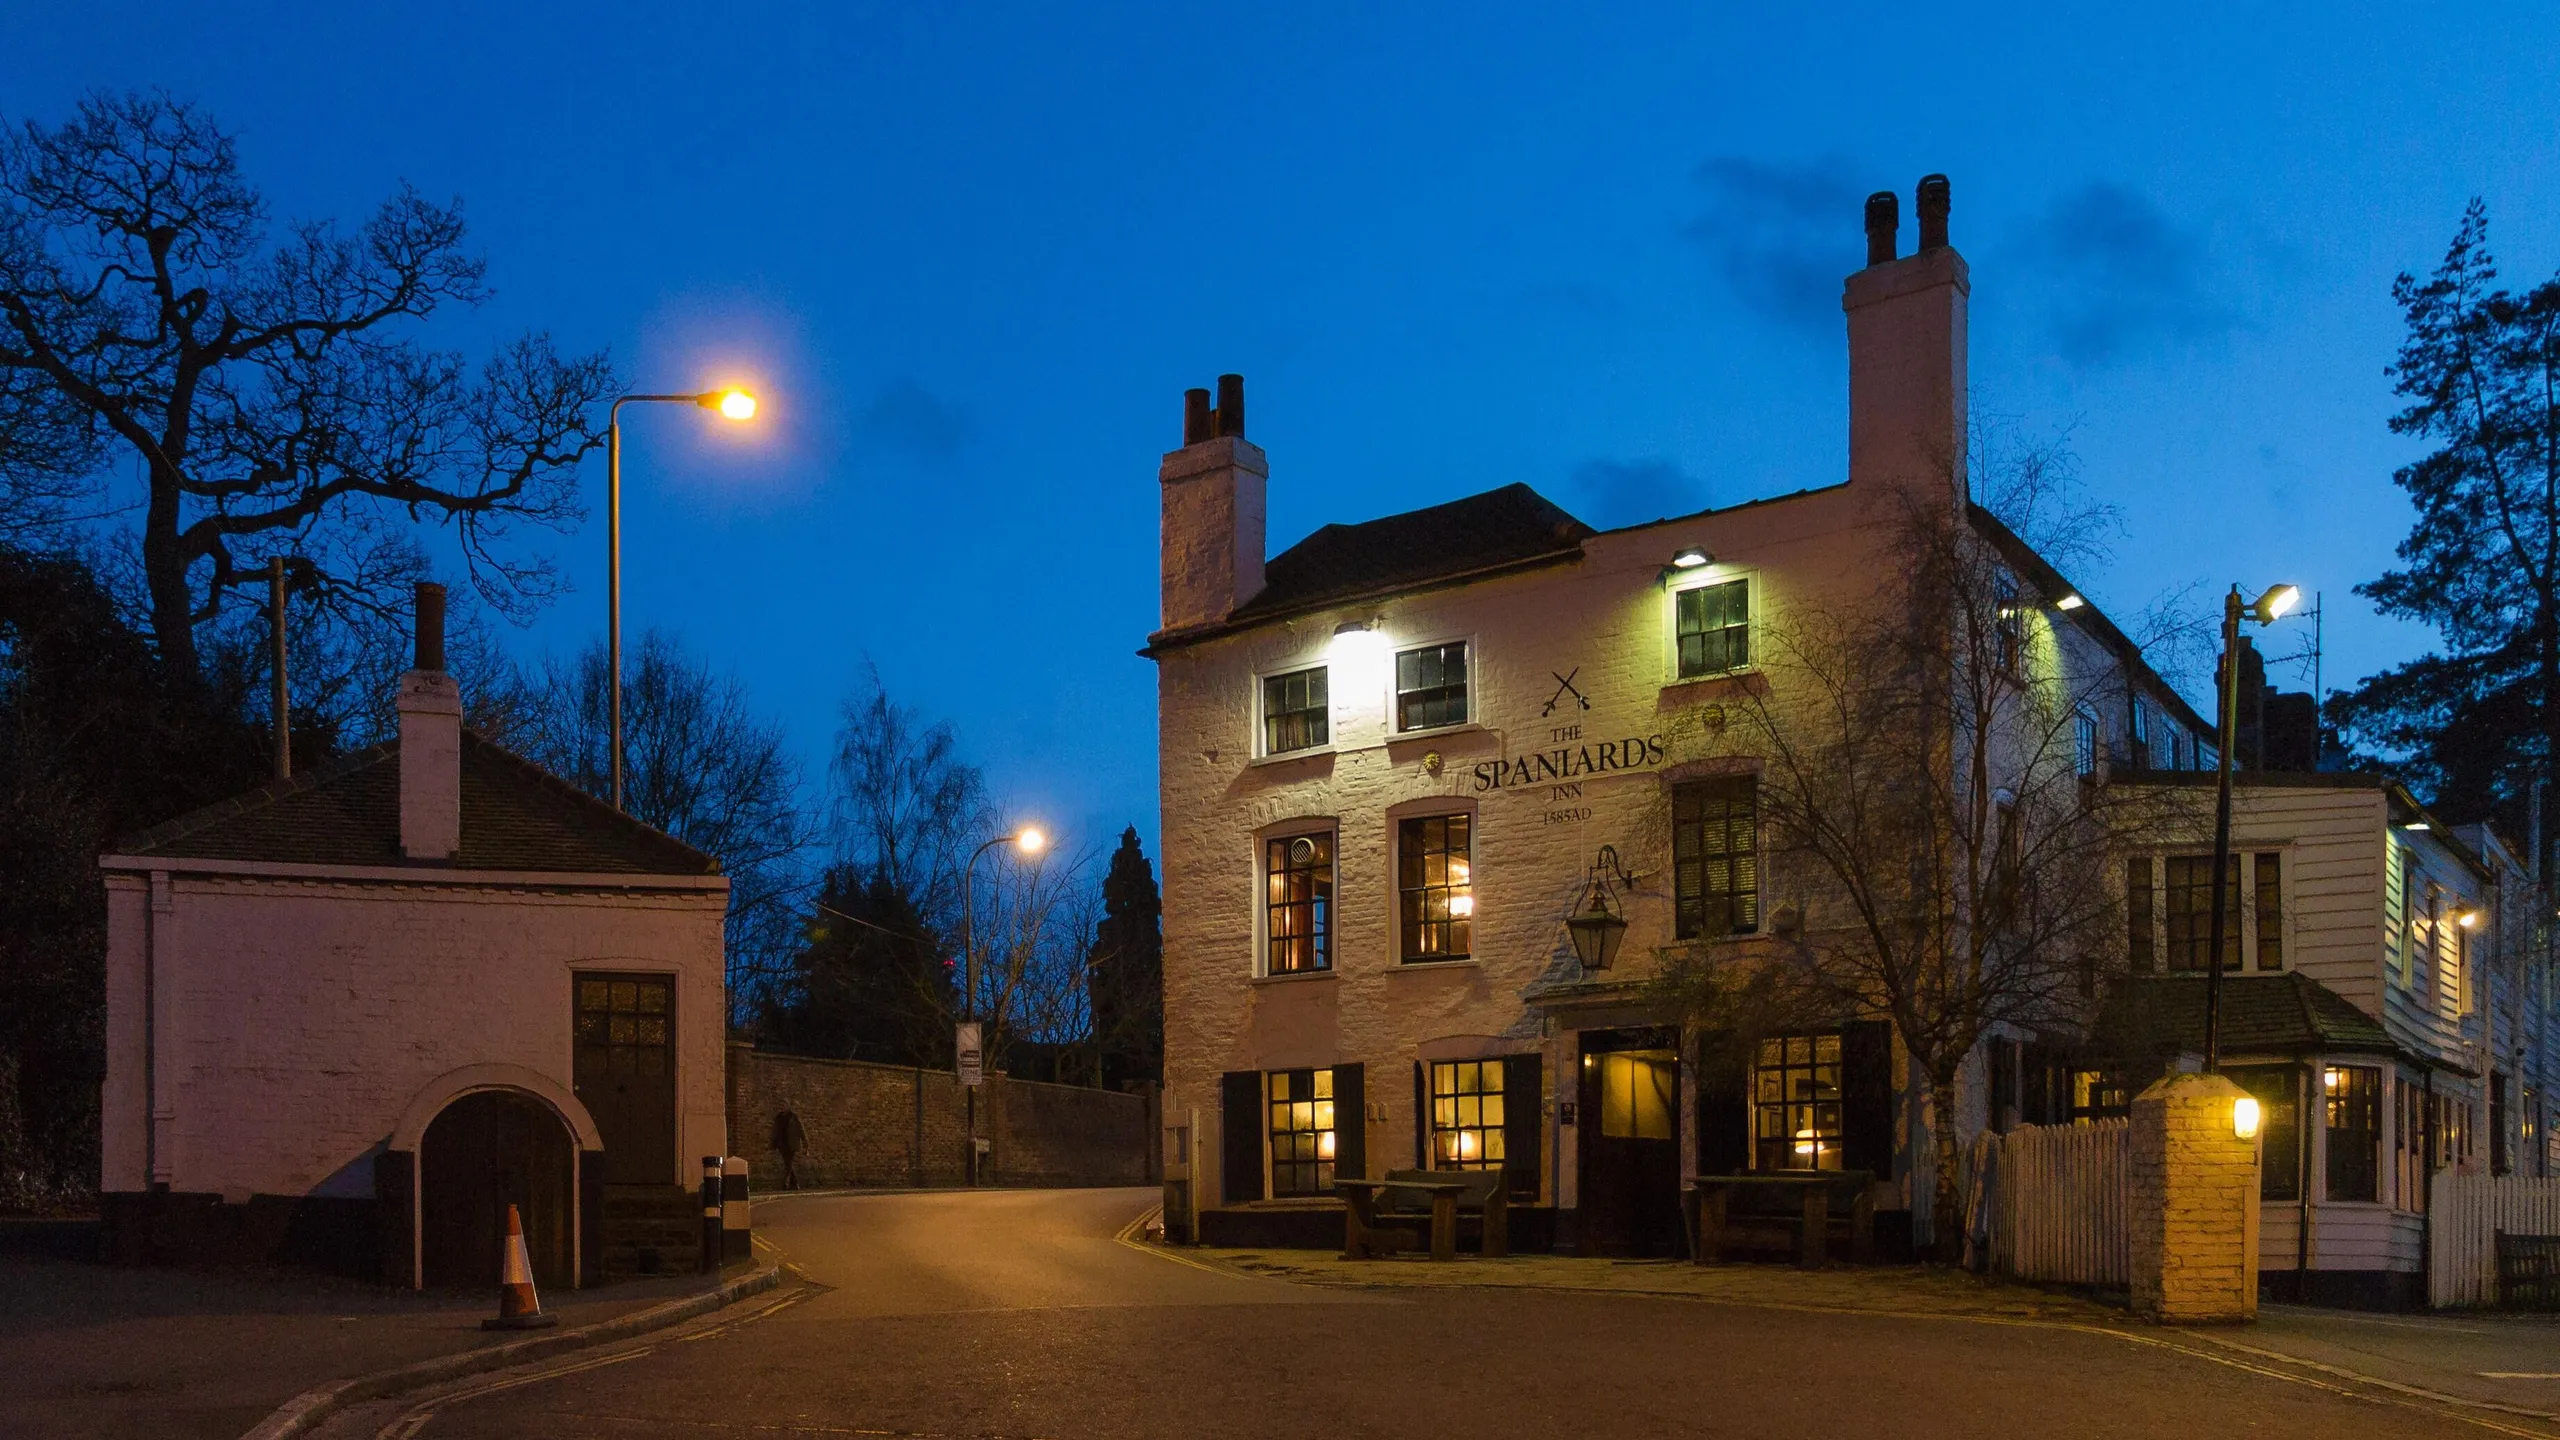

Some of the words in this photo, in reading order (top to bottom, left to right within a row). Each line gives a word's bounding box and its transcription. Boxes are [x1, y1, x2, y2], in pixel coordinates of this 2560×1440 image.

[1550, 725, 1582, 742] THE
[1474, 735, 1664, 791] SPANIARDS
[1552, 783, 1582, 801] INN
[1544, 808, 1592, 825] 1585AD
